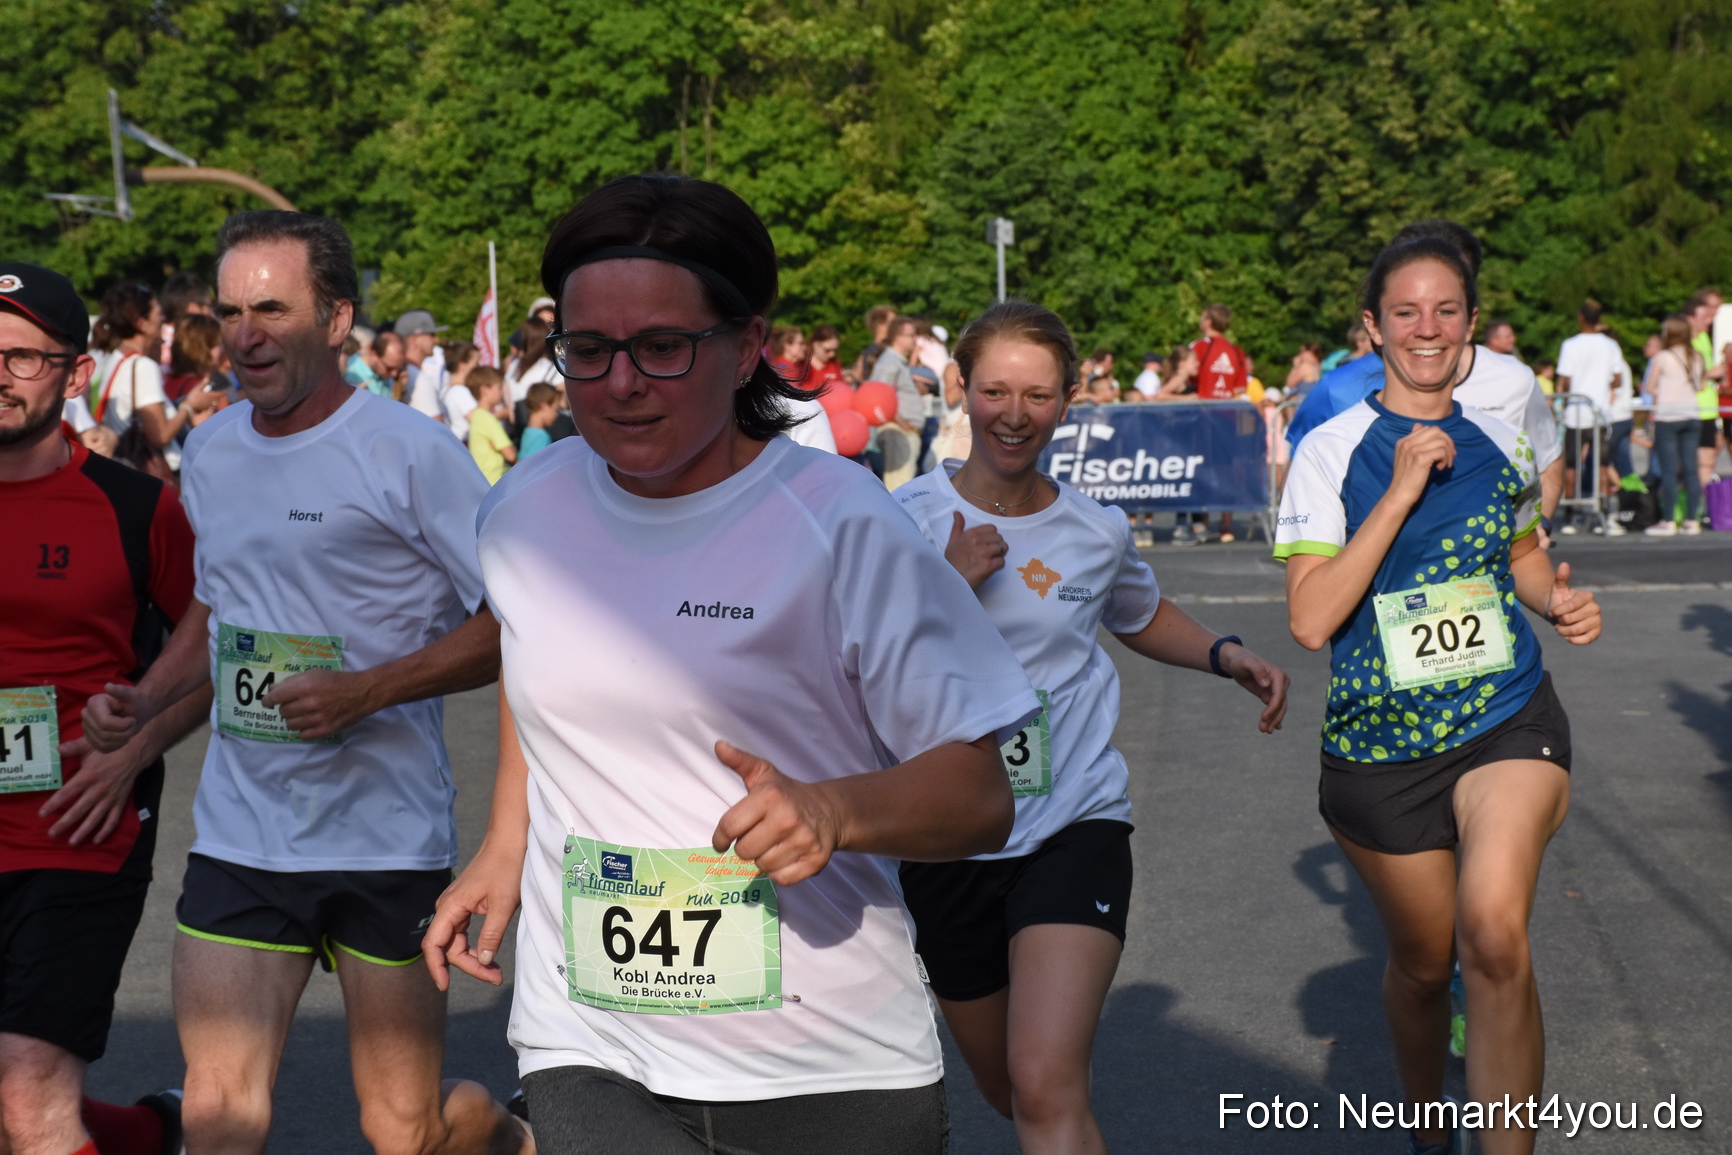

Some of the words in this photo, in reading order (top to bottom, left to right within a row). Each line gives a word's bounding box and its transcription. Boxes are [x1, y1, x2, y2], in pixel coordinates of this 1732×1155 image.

[1048, 449, 1204, 483] Fischer
[1080, 482, 1192, 500] UTOMOBILE
[288, 509, 323, 523] Horst
[37, 543, 70, 569] 13
[1031, 573, 1047, 583] NM
[1057, 585, 1092, 596] LANDKREIS
[1058, 593, 1092, 604] NEUMARKT
[676, 600, 755, 620] Andrea
[1411, 614, 1486, 659] 202
[1421, 655, 1455, 668] Erhard
[1457, 648, 1487, 661] Judith
[20, 713, 48, 724] 2019
[233, 706, 278, 722] Bernreiter
[1006, 730, 1030, 766] 3
[1009, 768, 1019, 777] ie
[687, 852, 728, 865] Gesunde
[704, 865, 733, 877] laufen
[589, 872, 666, 897] firmenlauf
[588, 889, 620, 900] neumarkt
[720, 889, 761, 905] 2019
[601, 906, 722, 968] 647
[613, 967, 649, 984] Kobl
[653, 971, 716, 986] Andrea
[621, 985, 639, 996] Die
[641, 987, 681, 999] Brücke
[684, 988, 706, 999] e.V.
